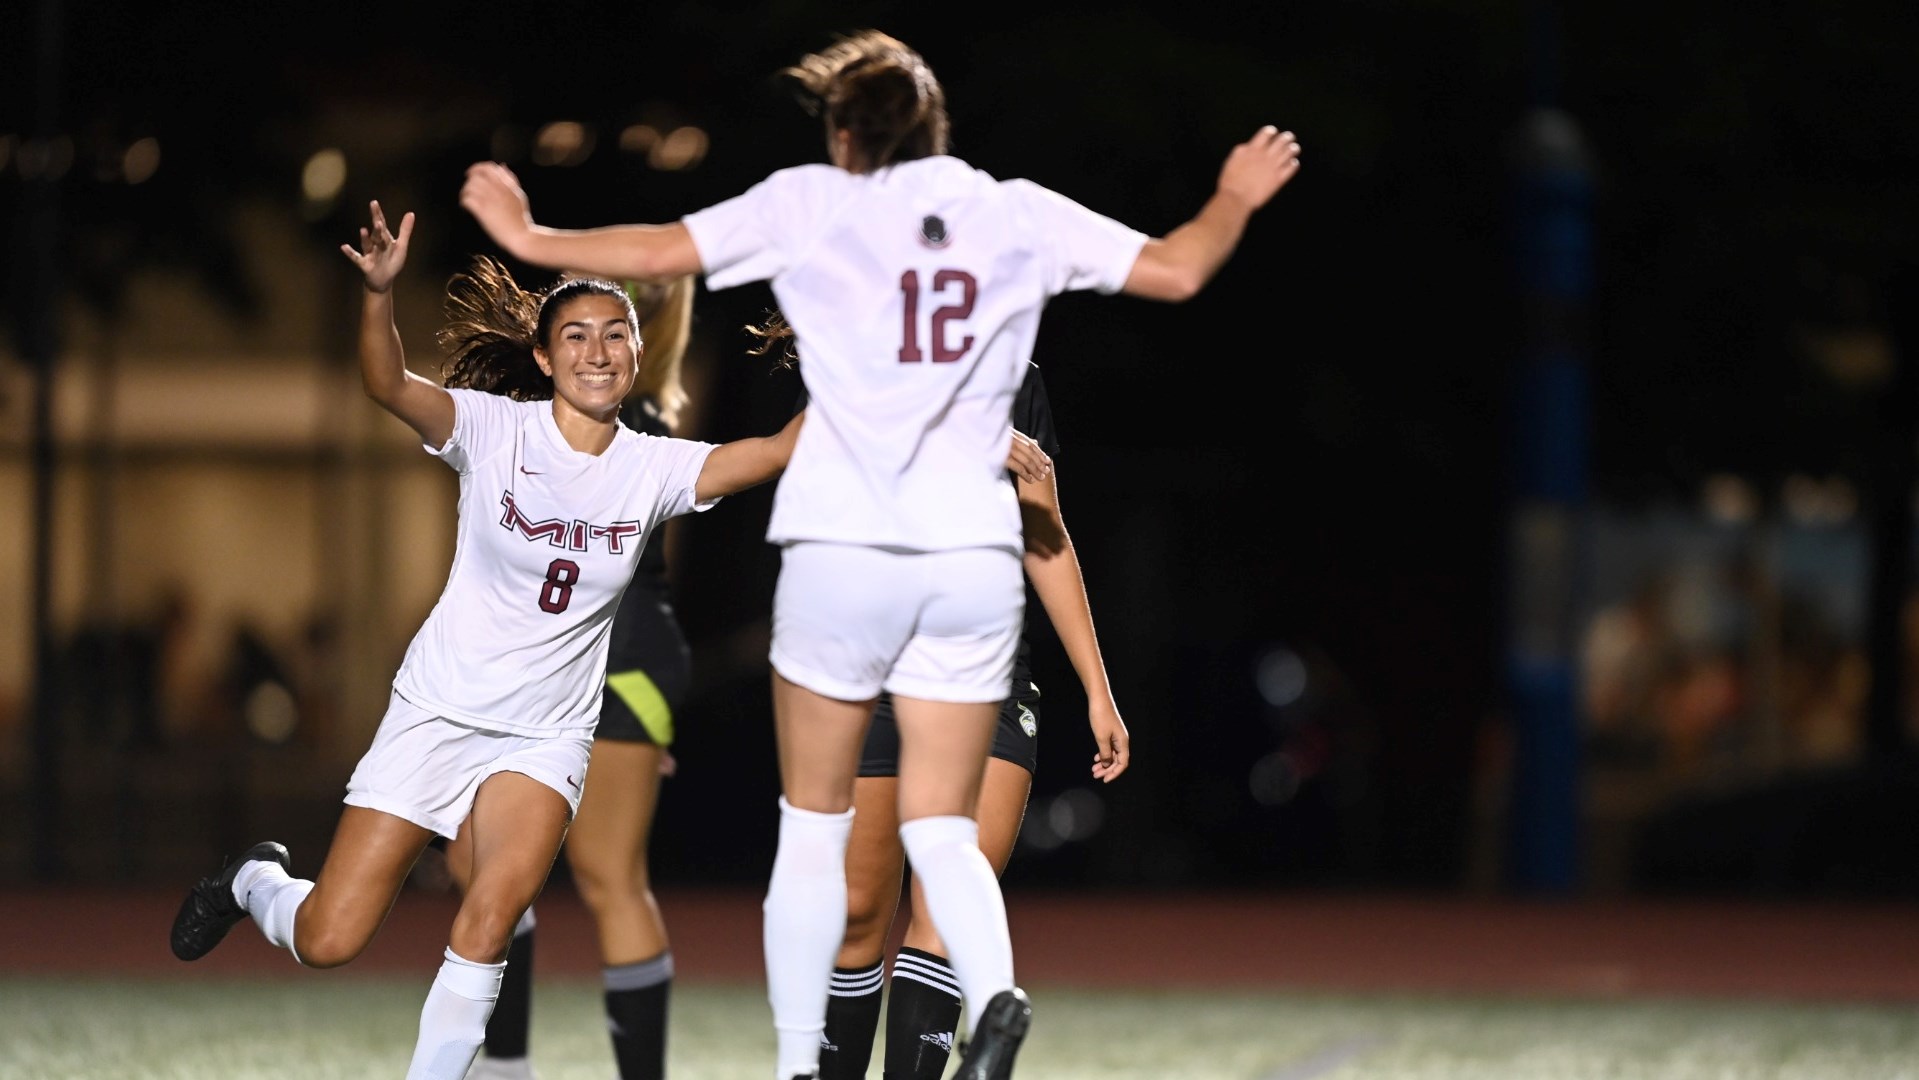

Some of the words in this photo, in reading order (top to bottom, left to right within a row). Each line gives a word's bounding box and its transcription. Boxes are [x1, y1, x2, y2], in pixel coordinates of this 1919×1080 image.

[898, 269, 978, 363] 12
[500, 489, 642, 555] MIT
[538, 558, 580, 615] 8
[919, 1033, 951, 1054] adida
